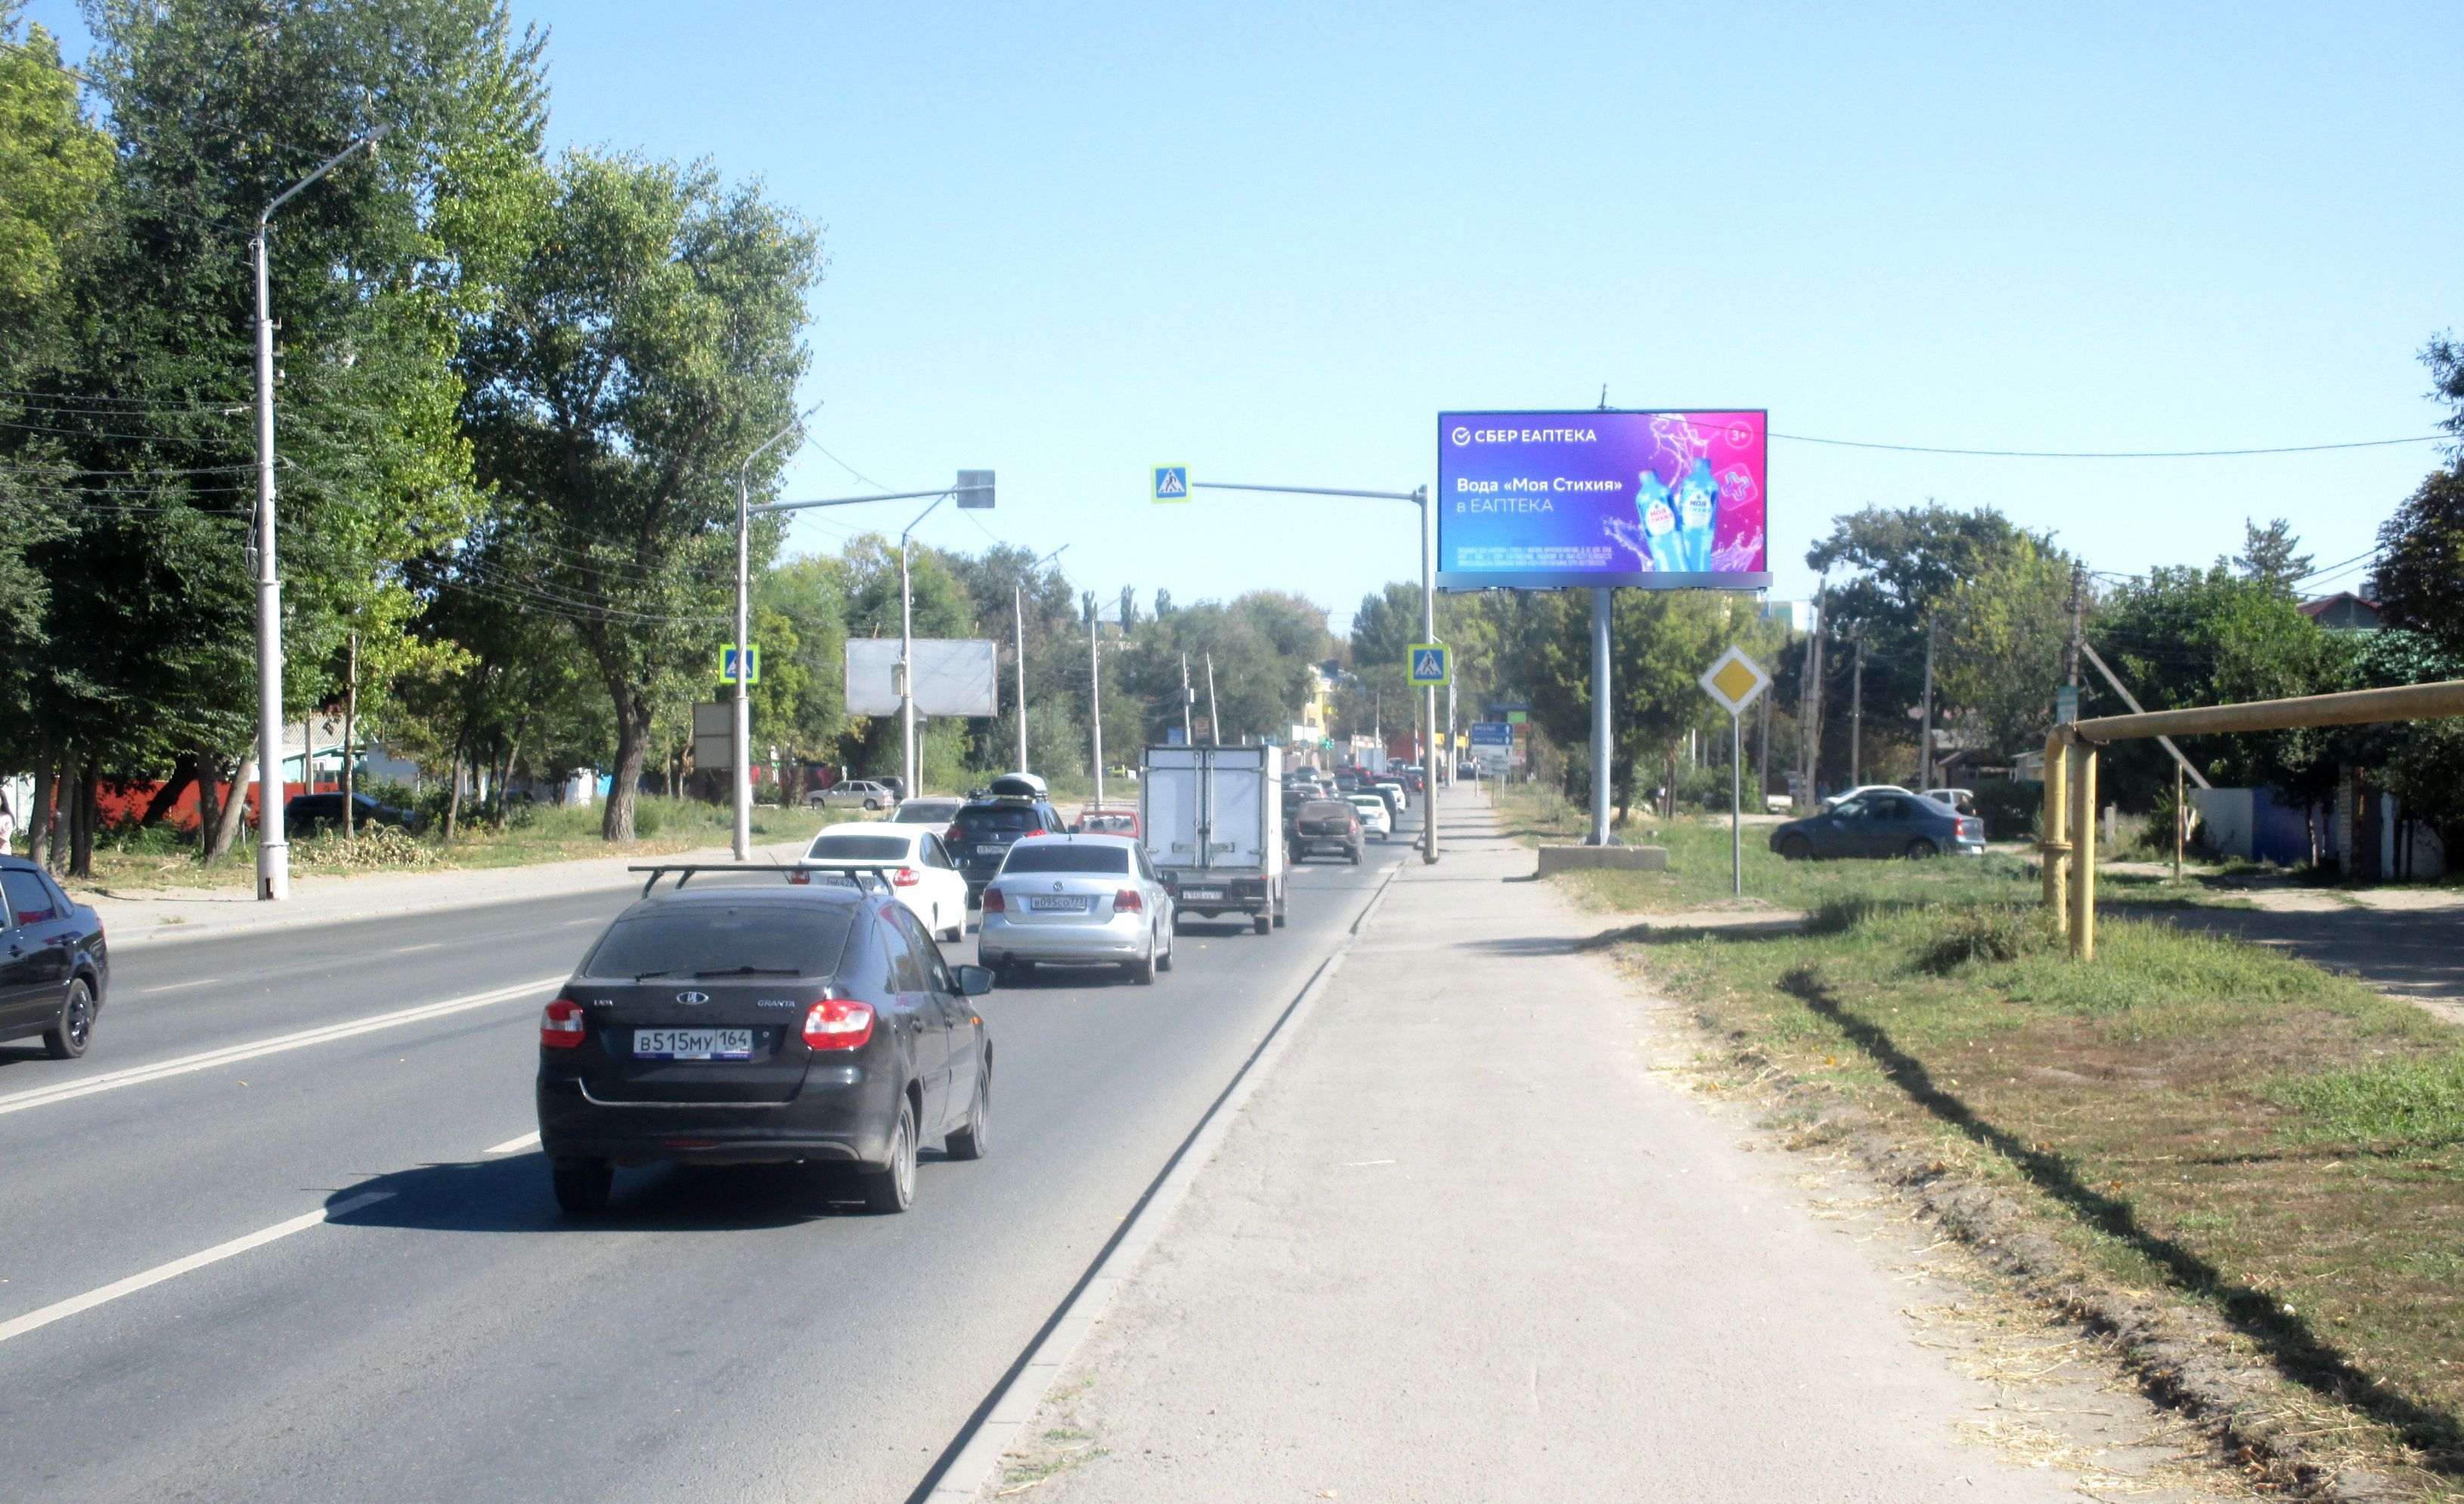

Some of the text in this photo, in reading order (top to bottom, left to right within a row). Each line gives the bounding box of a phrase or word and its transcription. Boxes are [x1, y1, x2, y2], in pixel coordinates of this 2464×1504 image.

[1475, 429, 1597, 442] СБЕР ЕАПТЕКА
[1731, 431, 1746, 442] 3+
[1457, 477, 1623, 494] Вода «Моя Стихия»
[1457, 499, 1554, 513] в ЕАПТЕКА
[1650, 508, 1667, 517] МОЯ
[758, 999, 795, 1007] GRANTA
[640, 1031, 748, 1051] В515МУ 164
